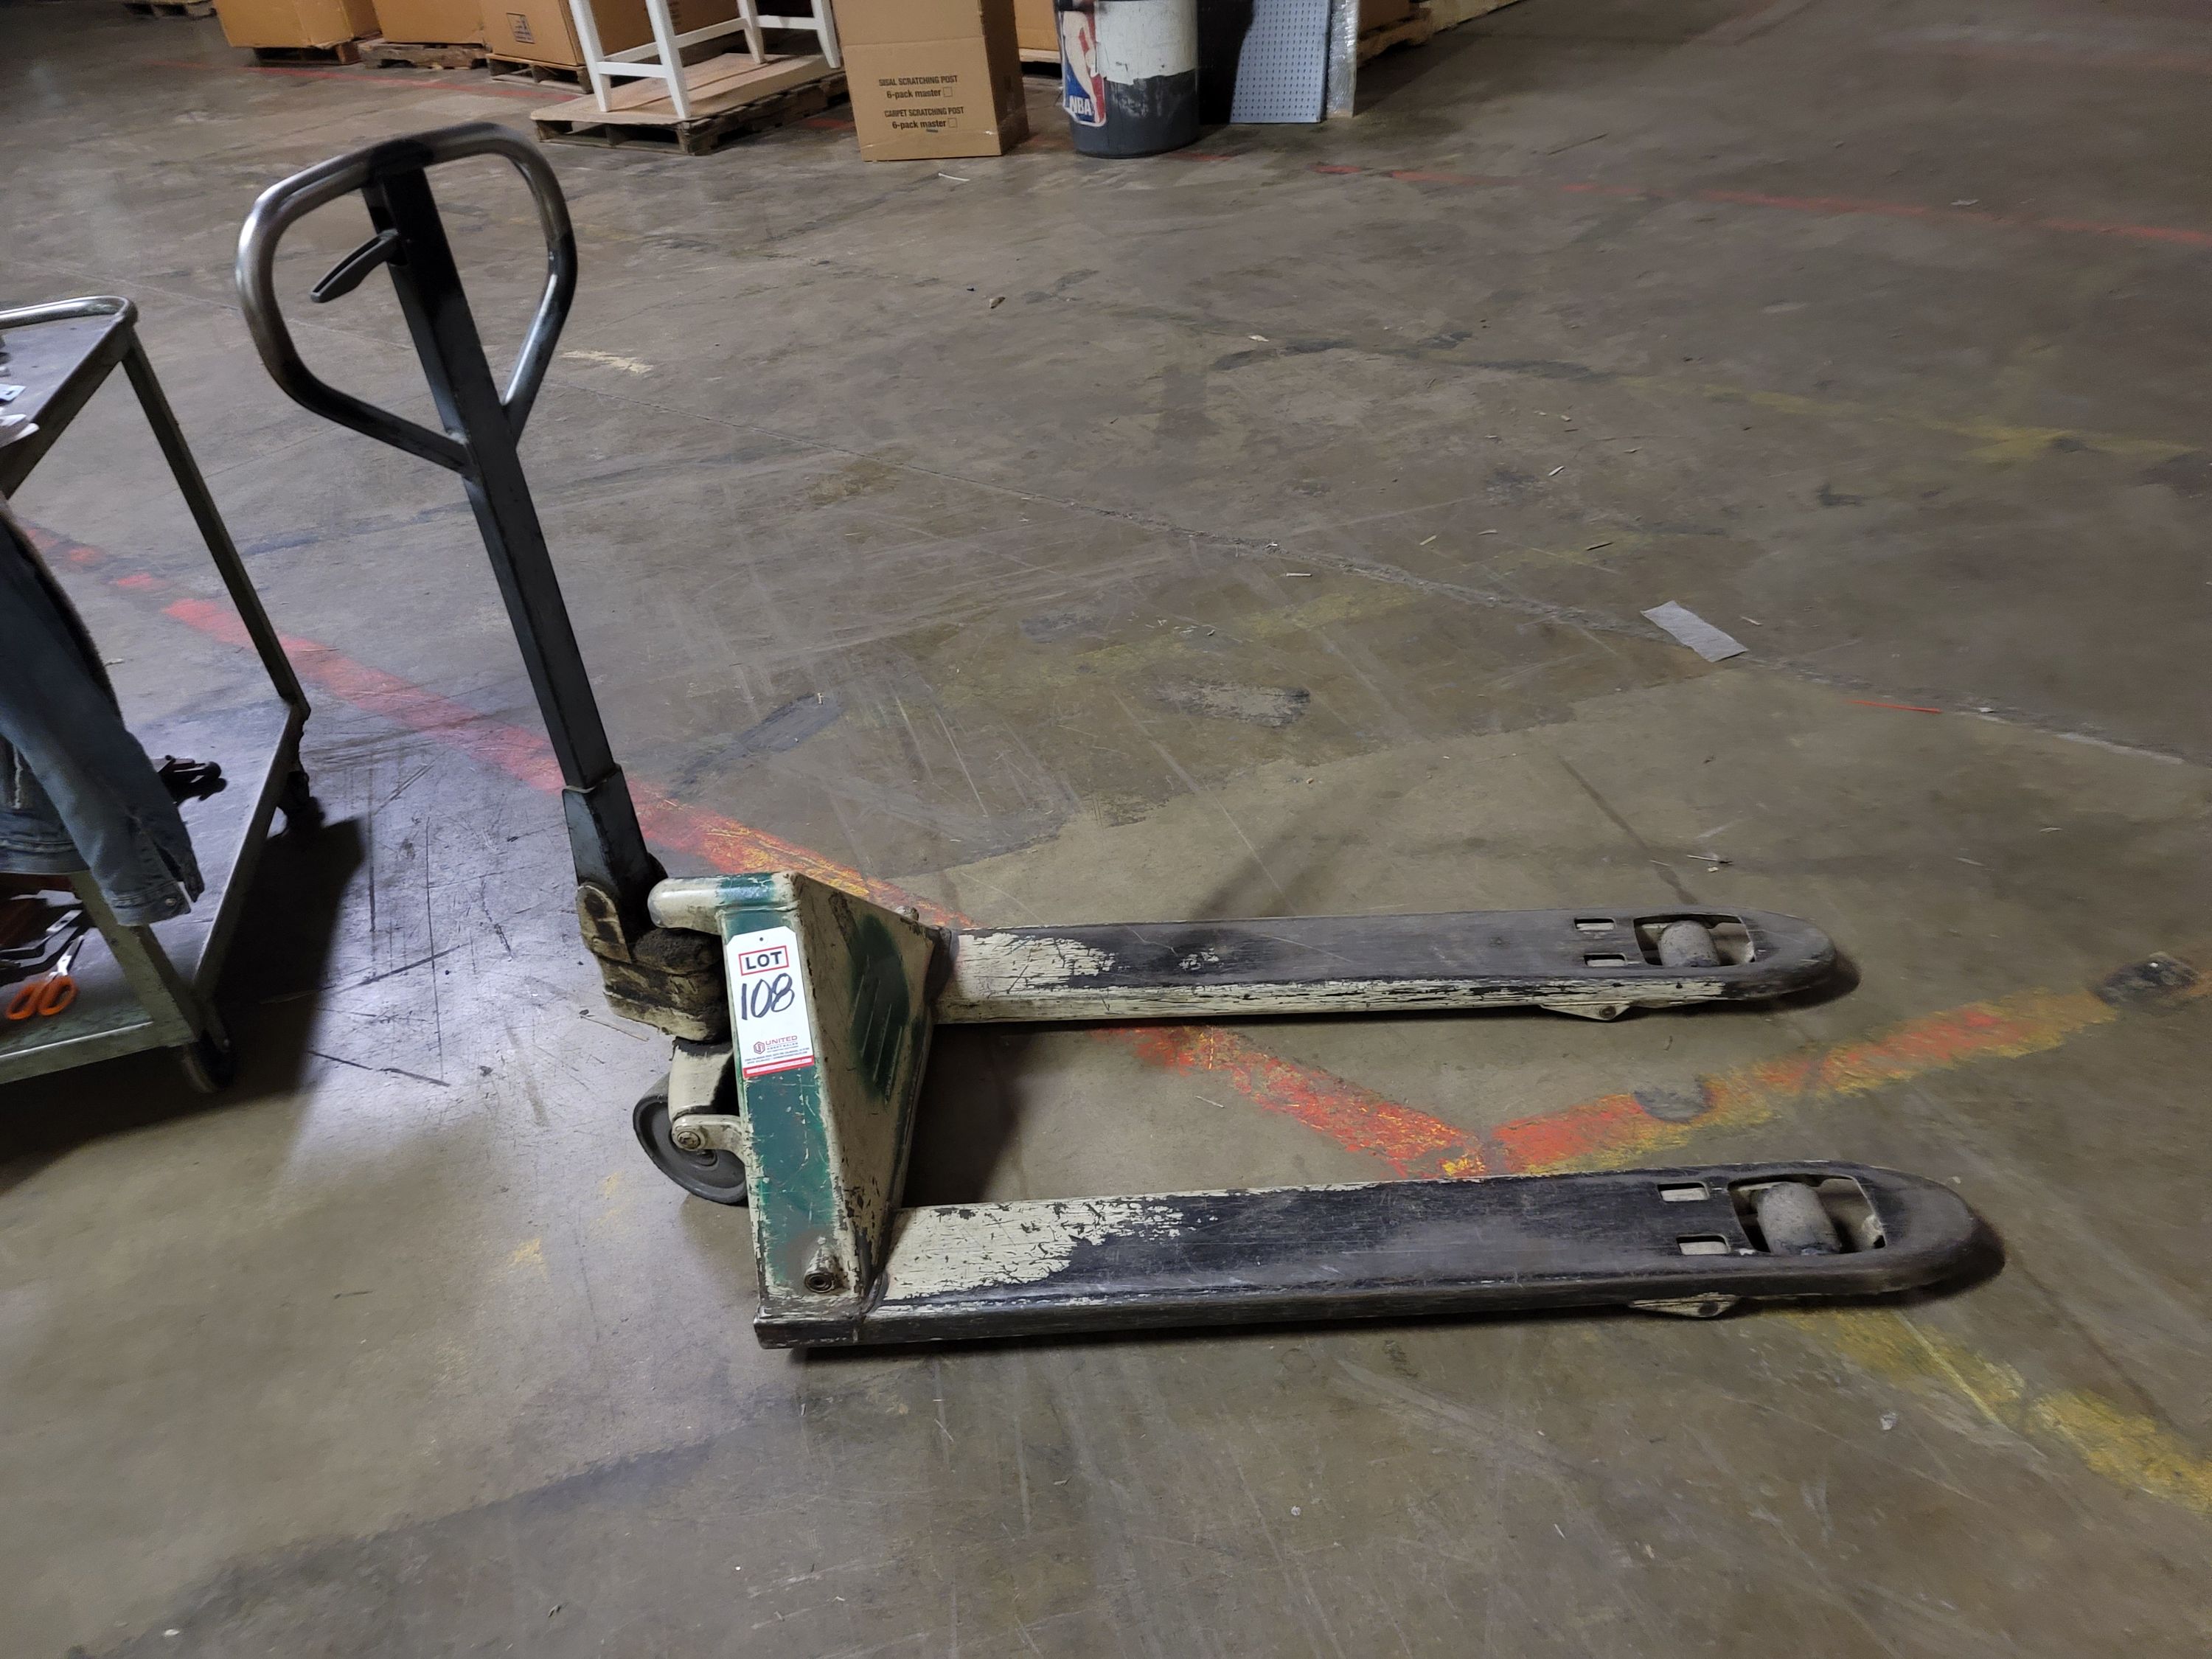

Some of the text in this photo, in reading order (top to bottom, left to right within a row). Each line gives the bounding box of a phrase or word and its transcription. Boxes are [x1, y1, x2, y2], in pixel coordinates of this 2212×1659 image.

[898, 76, 939, 86] SCRATCHING
[940, 75, 958, 83] POST
[886, 89, 941, 100] 6-pack master
[1068, 95, 1093, 116] NBA
[884, 106, 964, 118] CARPET SCRATCHING POST
[891, 119, 947, 131] 6-pack master
[745, 950, 782, 970] LOT
[741, 973, 795, 1020] 108
[765, 1035, 798, 1046] UNITED
